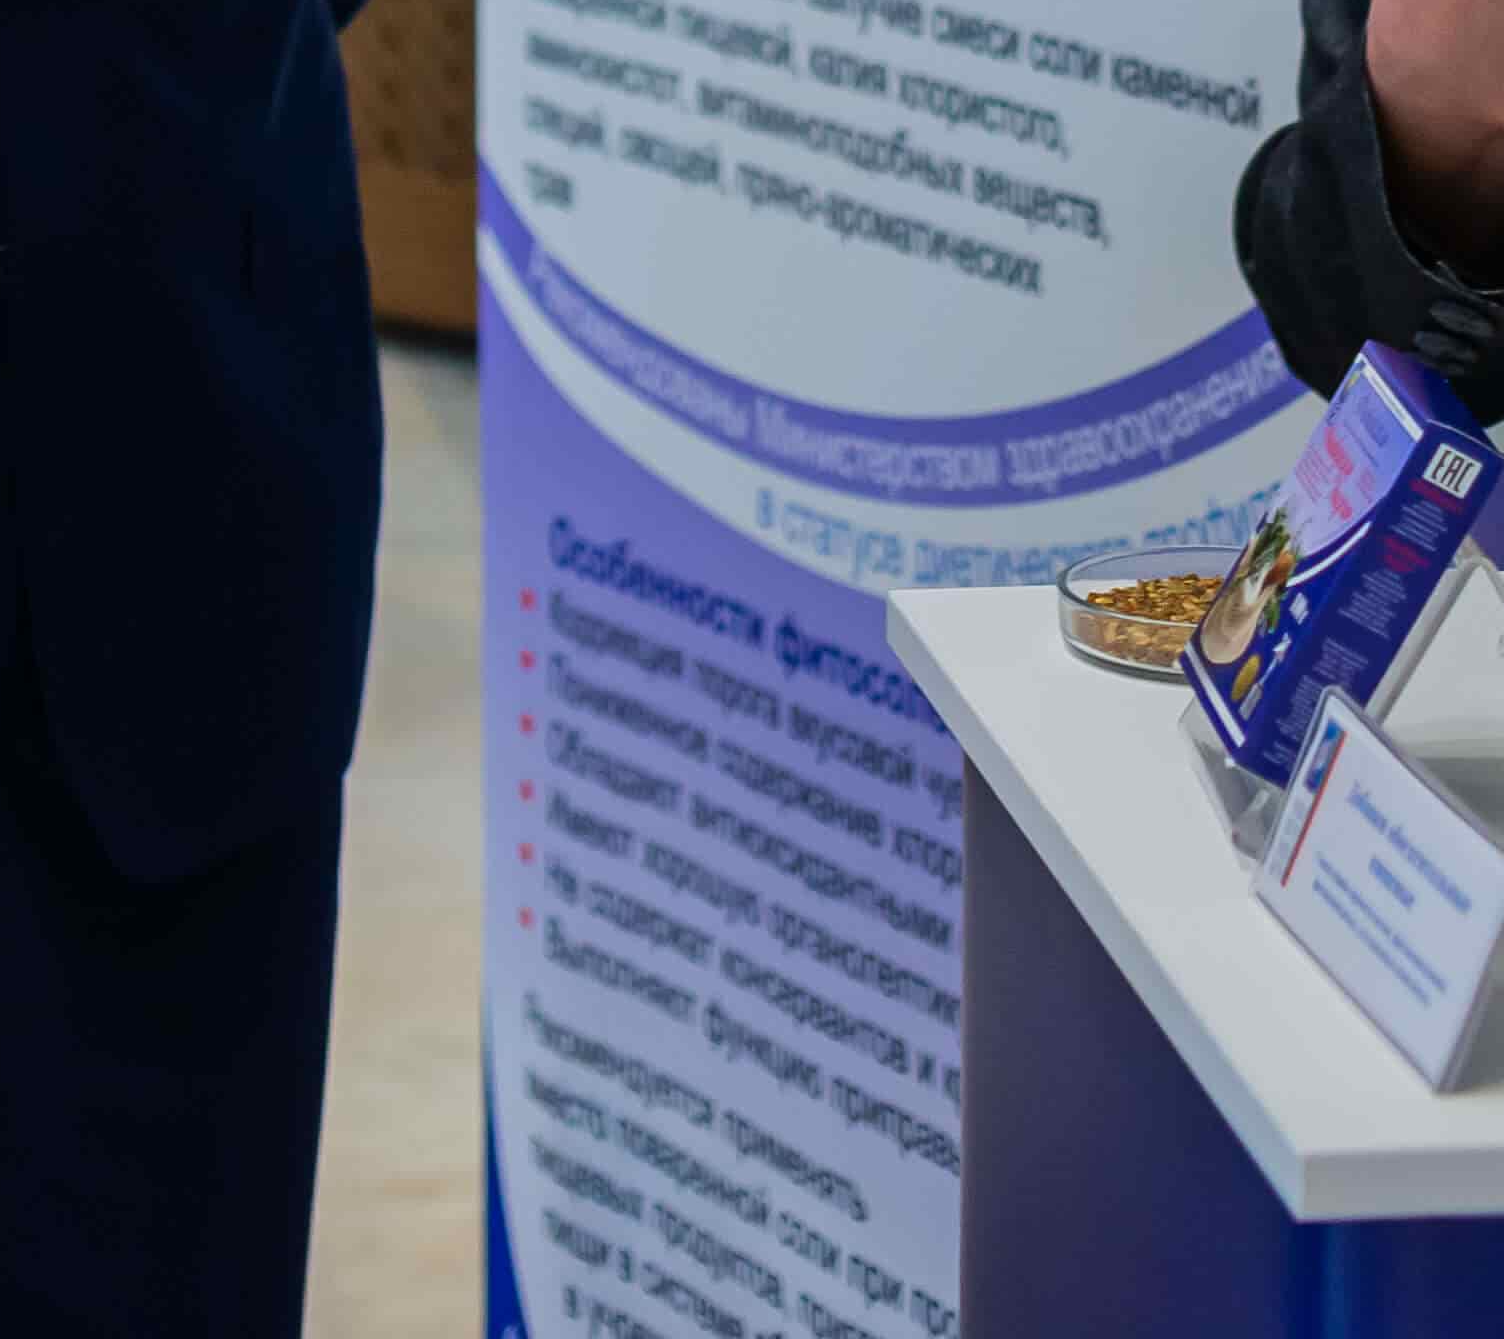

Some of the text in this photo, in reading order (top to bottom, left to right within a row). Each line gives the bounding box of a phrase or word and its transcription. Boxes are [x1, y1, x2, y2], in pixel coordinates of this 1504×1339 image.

[809, 45, 888, 96] калия
[899, 69, 1070, 159] хлористого,
[932, 5, 1020, 61] смеси
[1029, 32, 1101, 83] соли
[1112, 56, 1262, 129] каменной
[698, 79, 964, 195] витаминоподобных
[974, 166, 1112, 247] веществ,
[737, 161, 1043, 294] пряно-ароматических
[754, 395, 1002, 491] Министерством
[1006, 339, 1290, 493] здравоохранения
[549, 515, 765, 651] Особенности
[784, 500, 902, 583] статусе
[716, 736, 884, 849] содержание
[789, 705, 918, 789] вкусовой
[689, 793, 952, 950] антиоксидантными
[703, 999, 825, 1102] функцию
[720, 946, 910, 1077] консервантов
[917, 1051, 936, 1086] и
[722, 1109, 869, 1223] применять
[775, 1211, 841, 1271] соли
[846, 1253, 905, 1311] при
